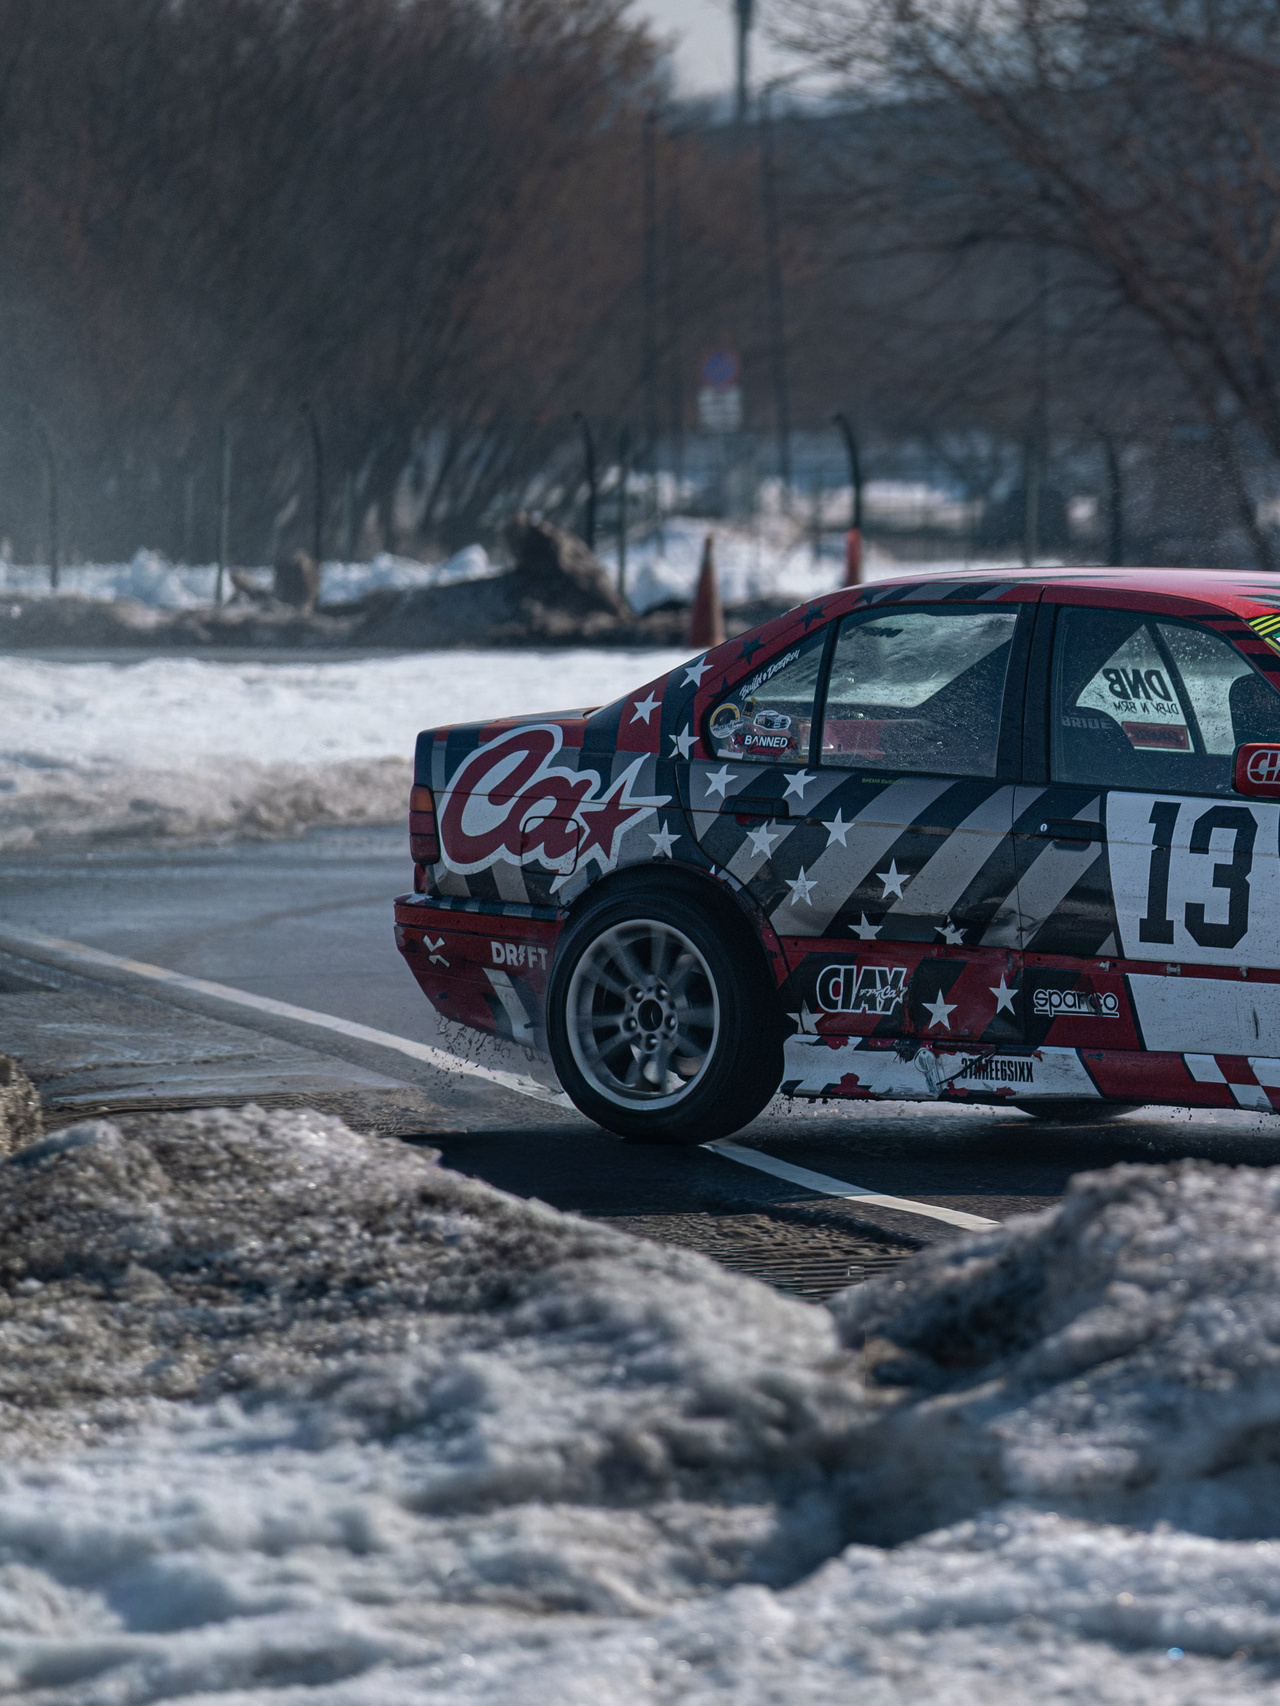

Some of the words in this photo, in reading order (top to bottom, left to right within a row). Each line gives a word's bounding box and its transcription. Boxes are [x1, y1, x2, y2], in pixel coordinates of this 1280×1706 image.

[744, 734, 789, 748] BANNED
[1138, 800, 1259, 950] 13
[490, 941, 549, 971] DRIFT
[1033, 987, 1119, 1017] sparco
